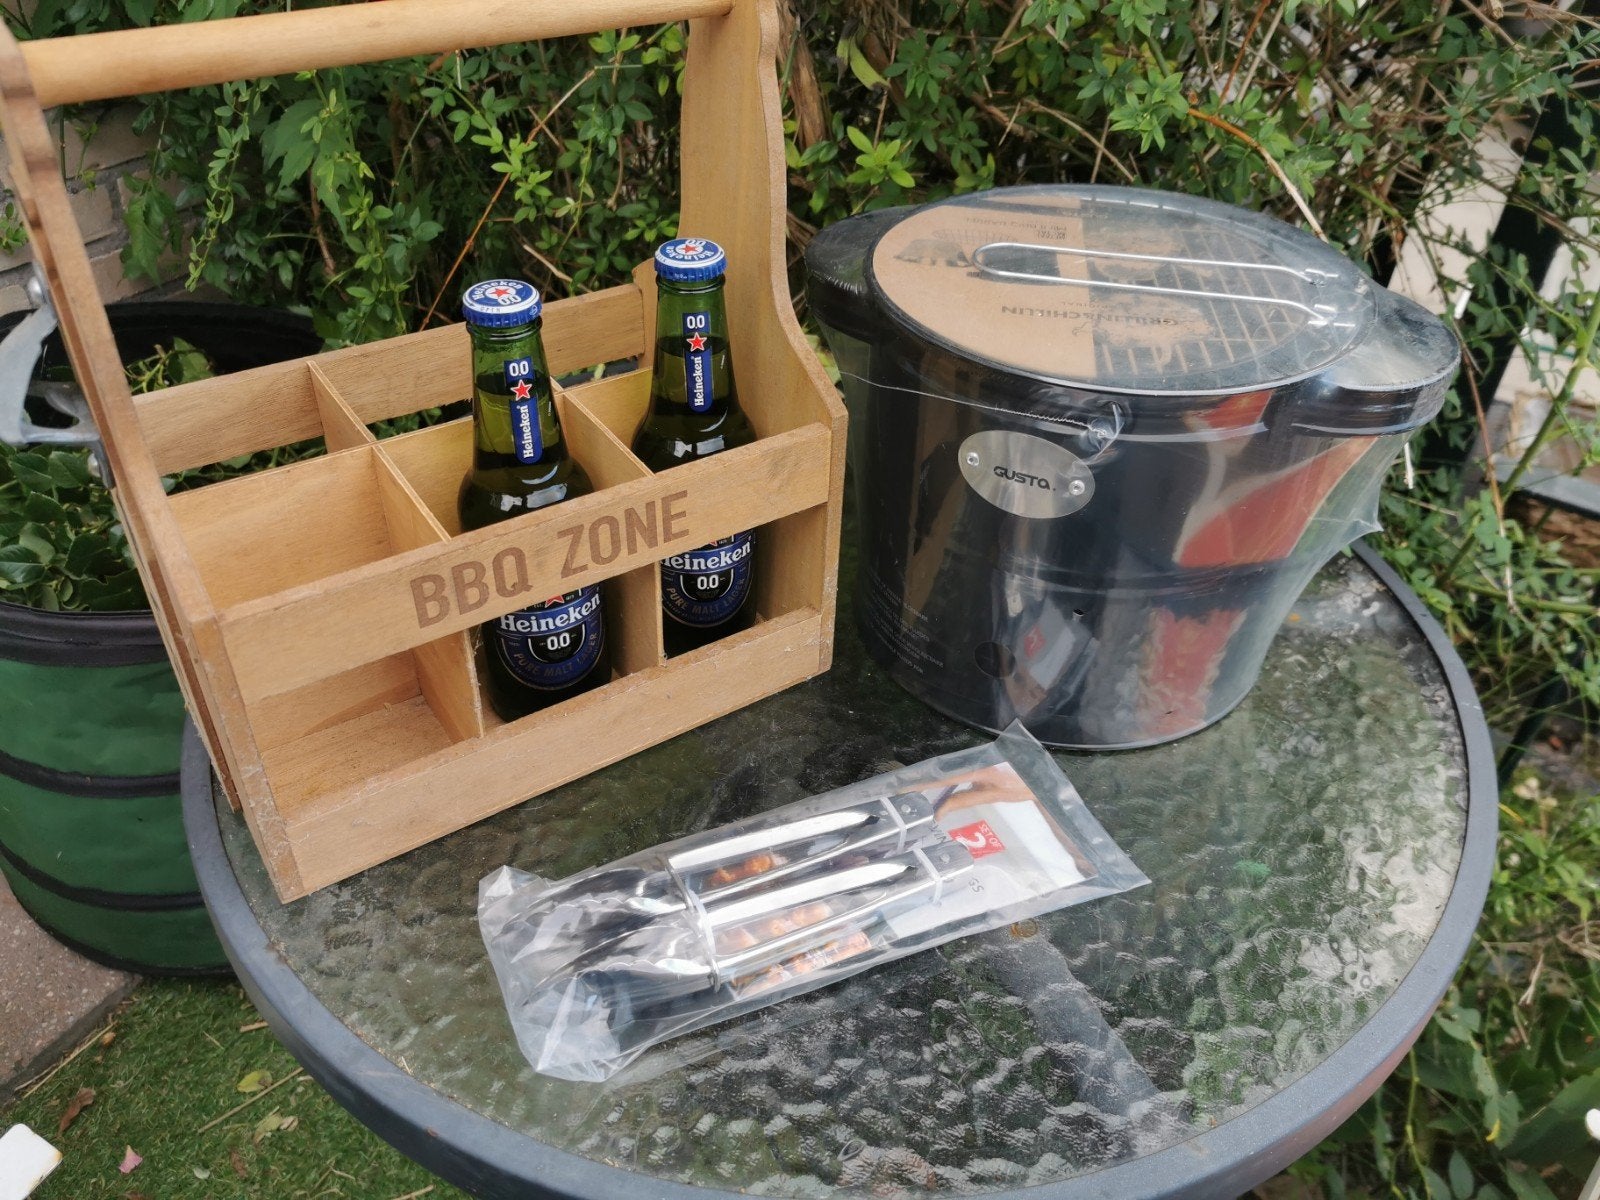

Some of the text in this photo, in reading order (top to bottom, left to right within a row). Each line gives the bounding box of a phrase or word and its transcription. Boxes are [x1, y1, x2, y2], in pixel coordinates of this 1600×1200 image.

[665, 245, 715, 260] Heineken
[471, 281, 524, 301] Heineken
[686, 314, 706, 329] 0.0
[508, 360, 530, 378] 0.0
[692, 356, 705, 407] Heineken
[519, 404, 534, 459] Heineken
[409, 489, 690, 629] BBQ ZONE
[696, 574, 719, 590] 0.0
[666, 587, 689, 610] PURE
[691, 602, 720, 615] MALT
[500, 593, 601, 633] Heineken
[546, 632, 571, 651] 0.0
[513, 652, 541, 675] PURE
[543, 662, 575, 678] MALT
[953, 831, 986, 850] 2
